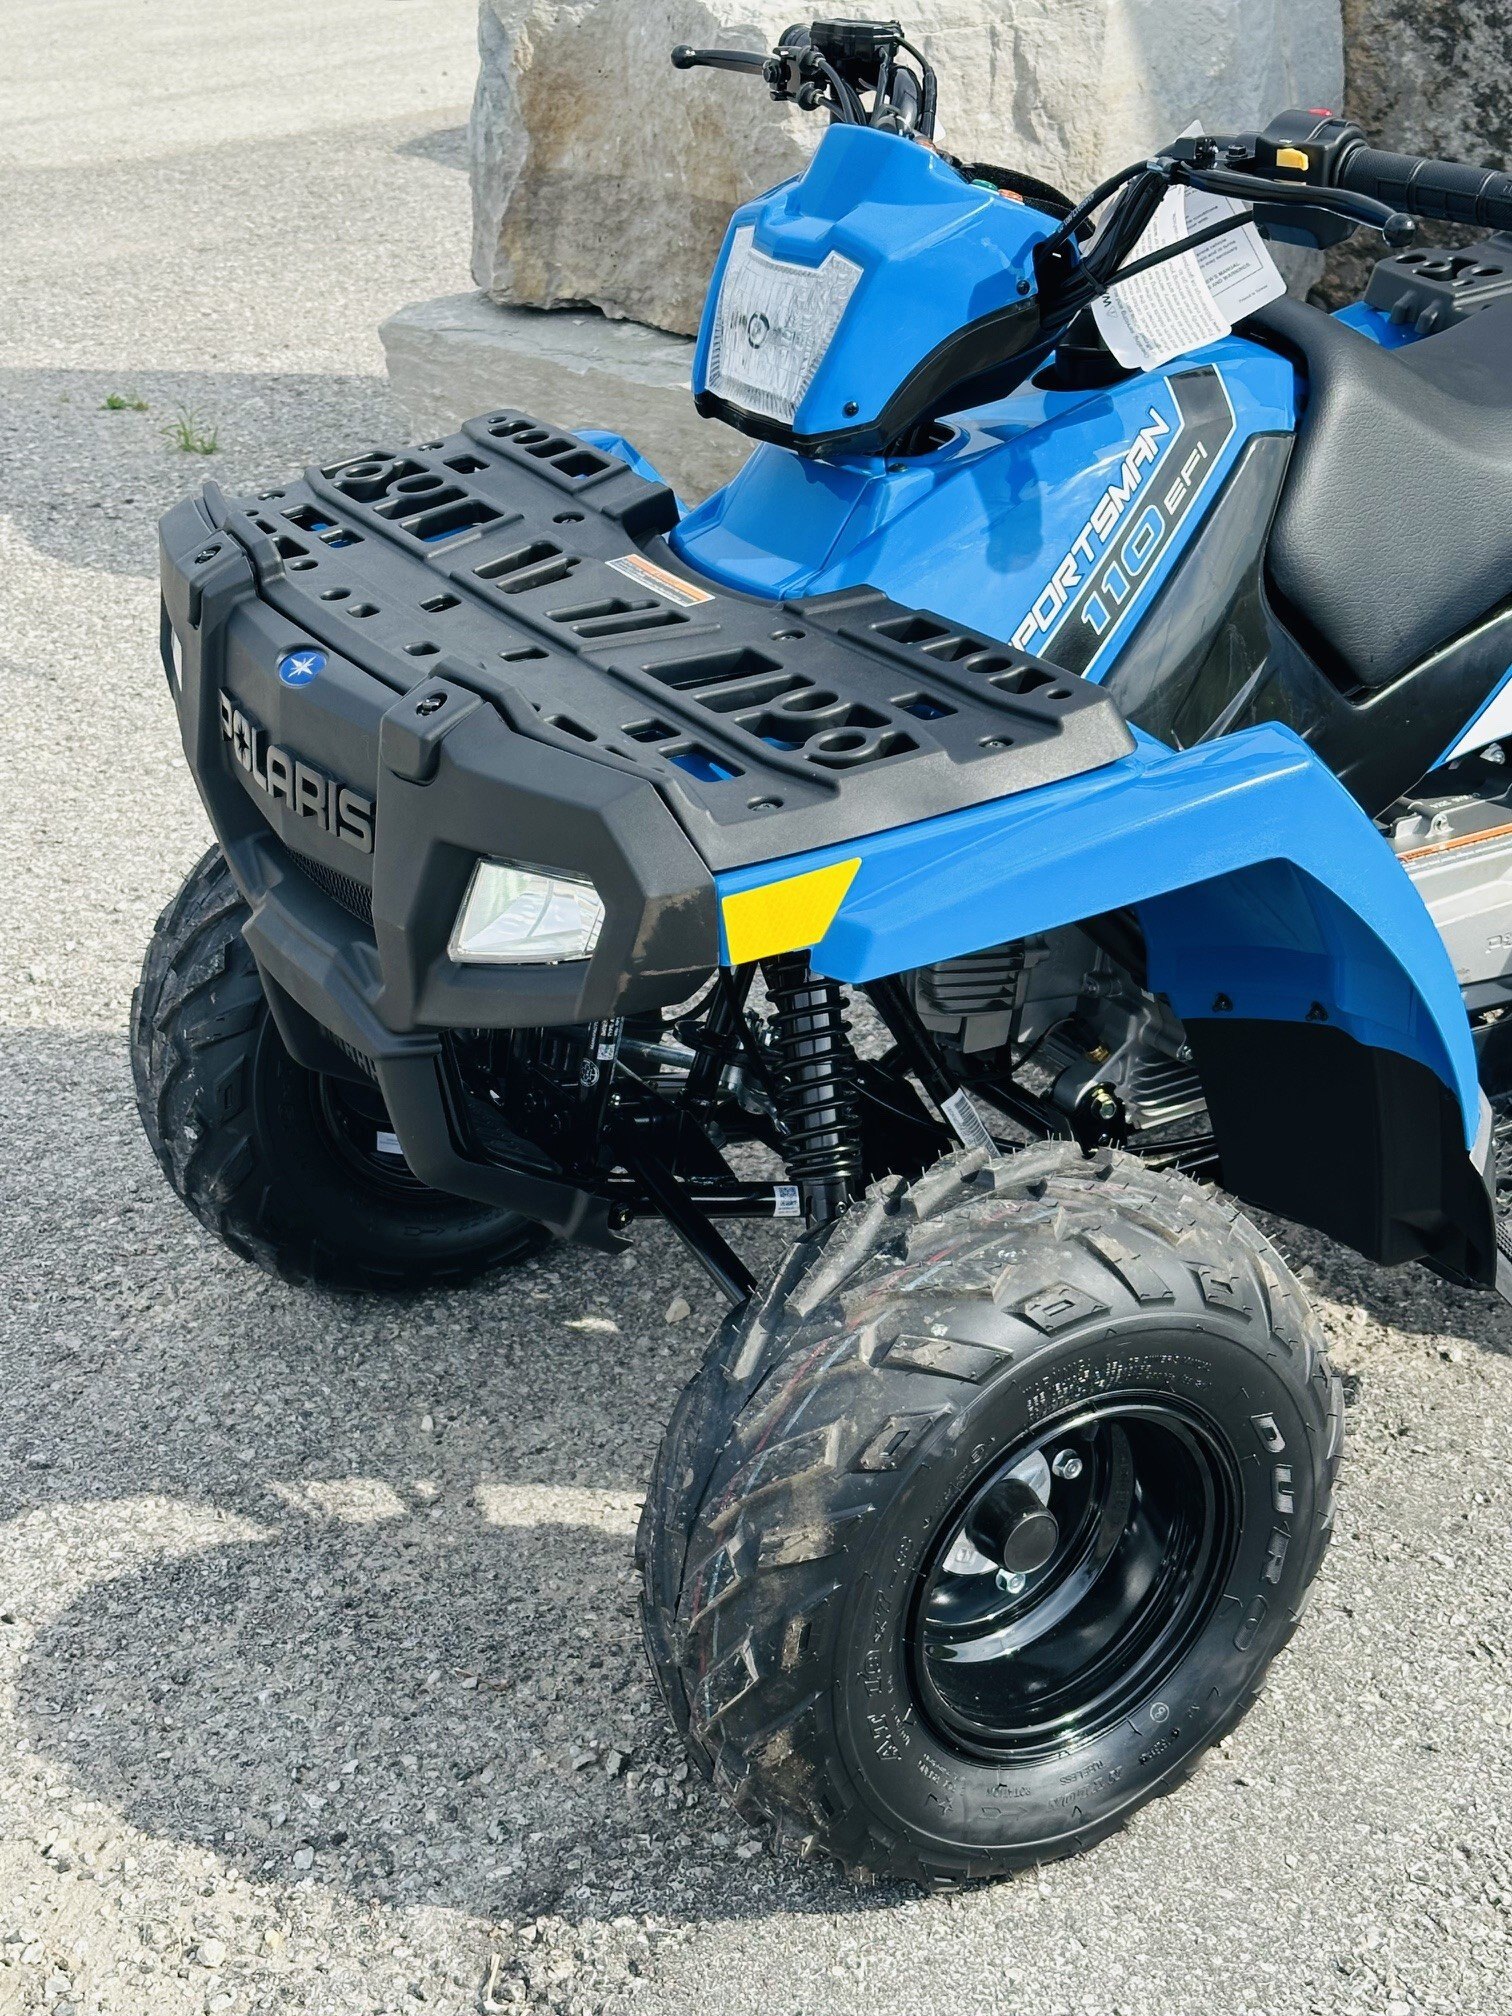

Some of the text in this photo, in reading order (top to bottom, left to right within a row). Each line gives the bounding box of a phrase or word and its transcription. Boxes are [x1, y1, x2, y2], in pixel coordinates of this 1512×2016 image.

[1008, 406, 1171, 652] PORTSMAN
[1081, 440, 1208, 636] 110 EFI
[218, 687, 377, 855] POLARIS
[1234, 1412, 1294, 1651] DURO
